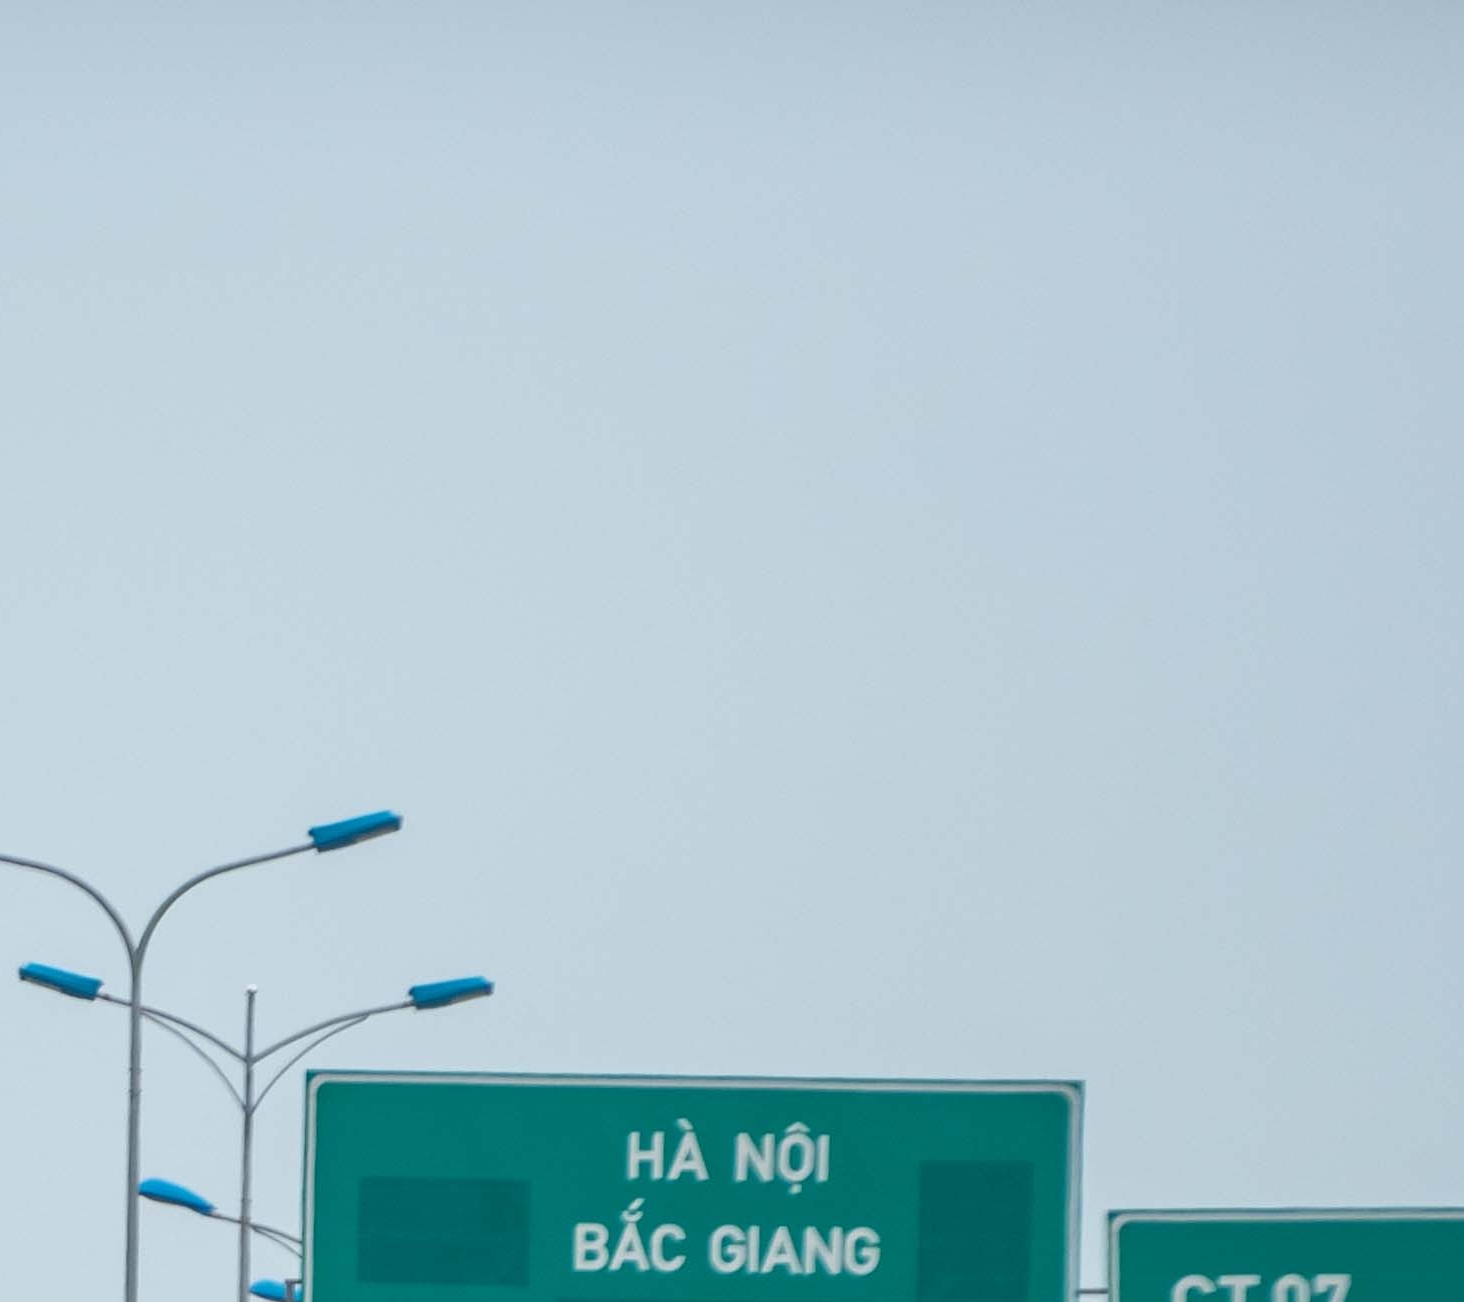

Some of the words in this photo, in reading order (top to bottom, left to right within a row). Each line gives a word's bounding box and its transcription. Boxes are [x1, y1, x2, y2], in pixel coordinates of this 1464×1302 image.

[626, 1118, 710, 1182] HÀ
[734, 1121, 831, 1195] NỘI
[572, 1198, 687, 1273] BẮC
[708, 1224, 881, 1276] GIANG
